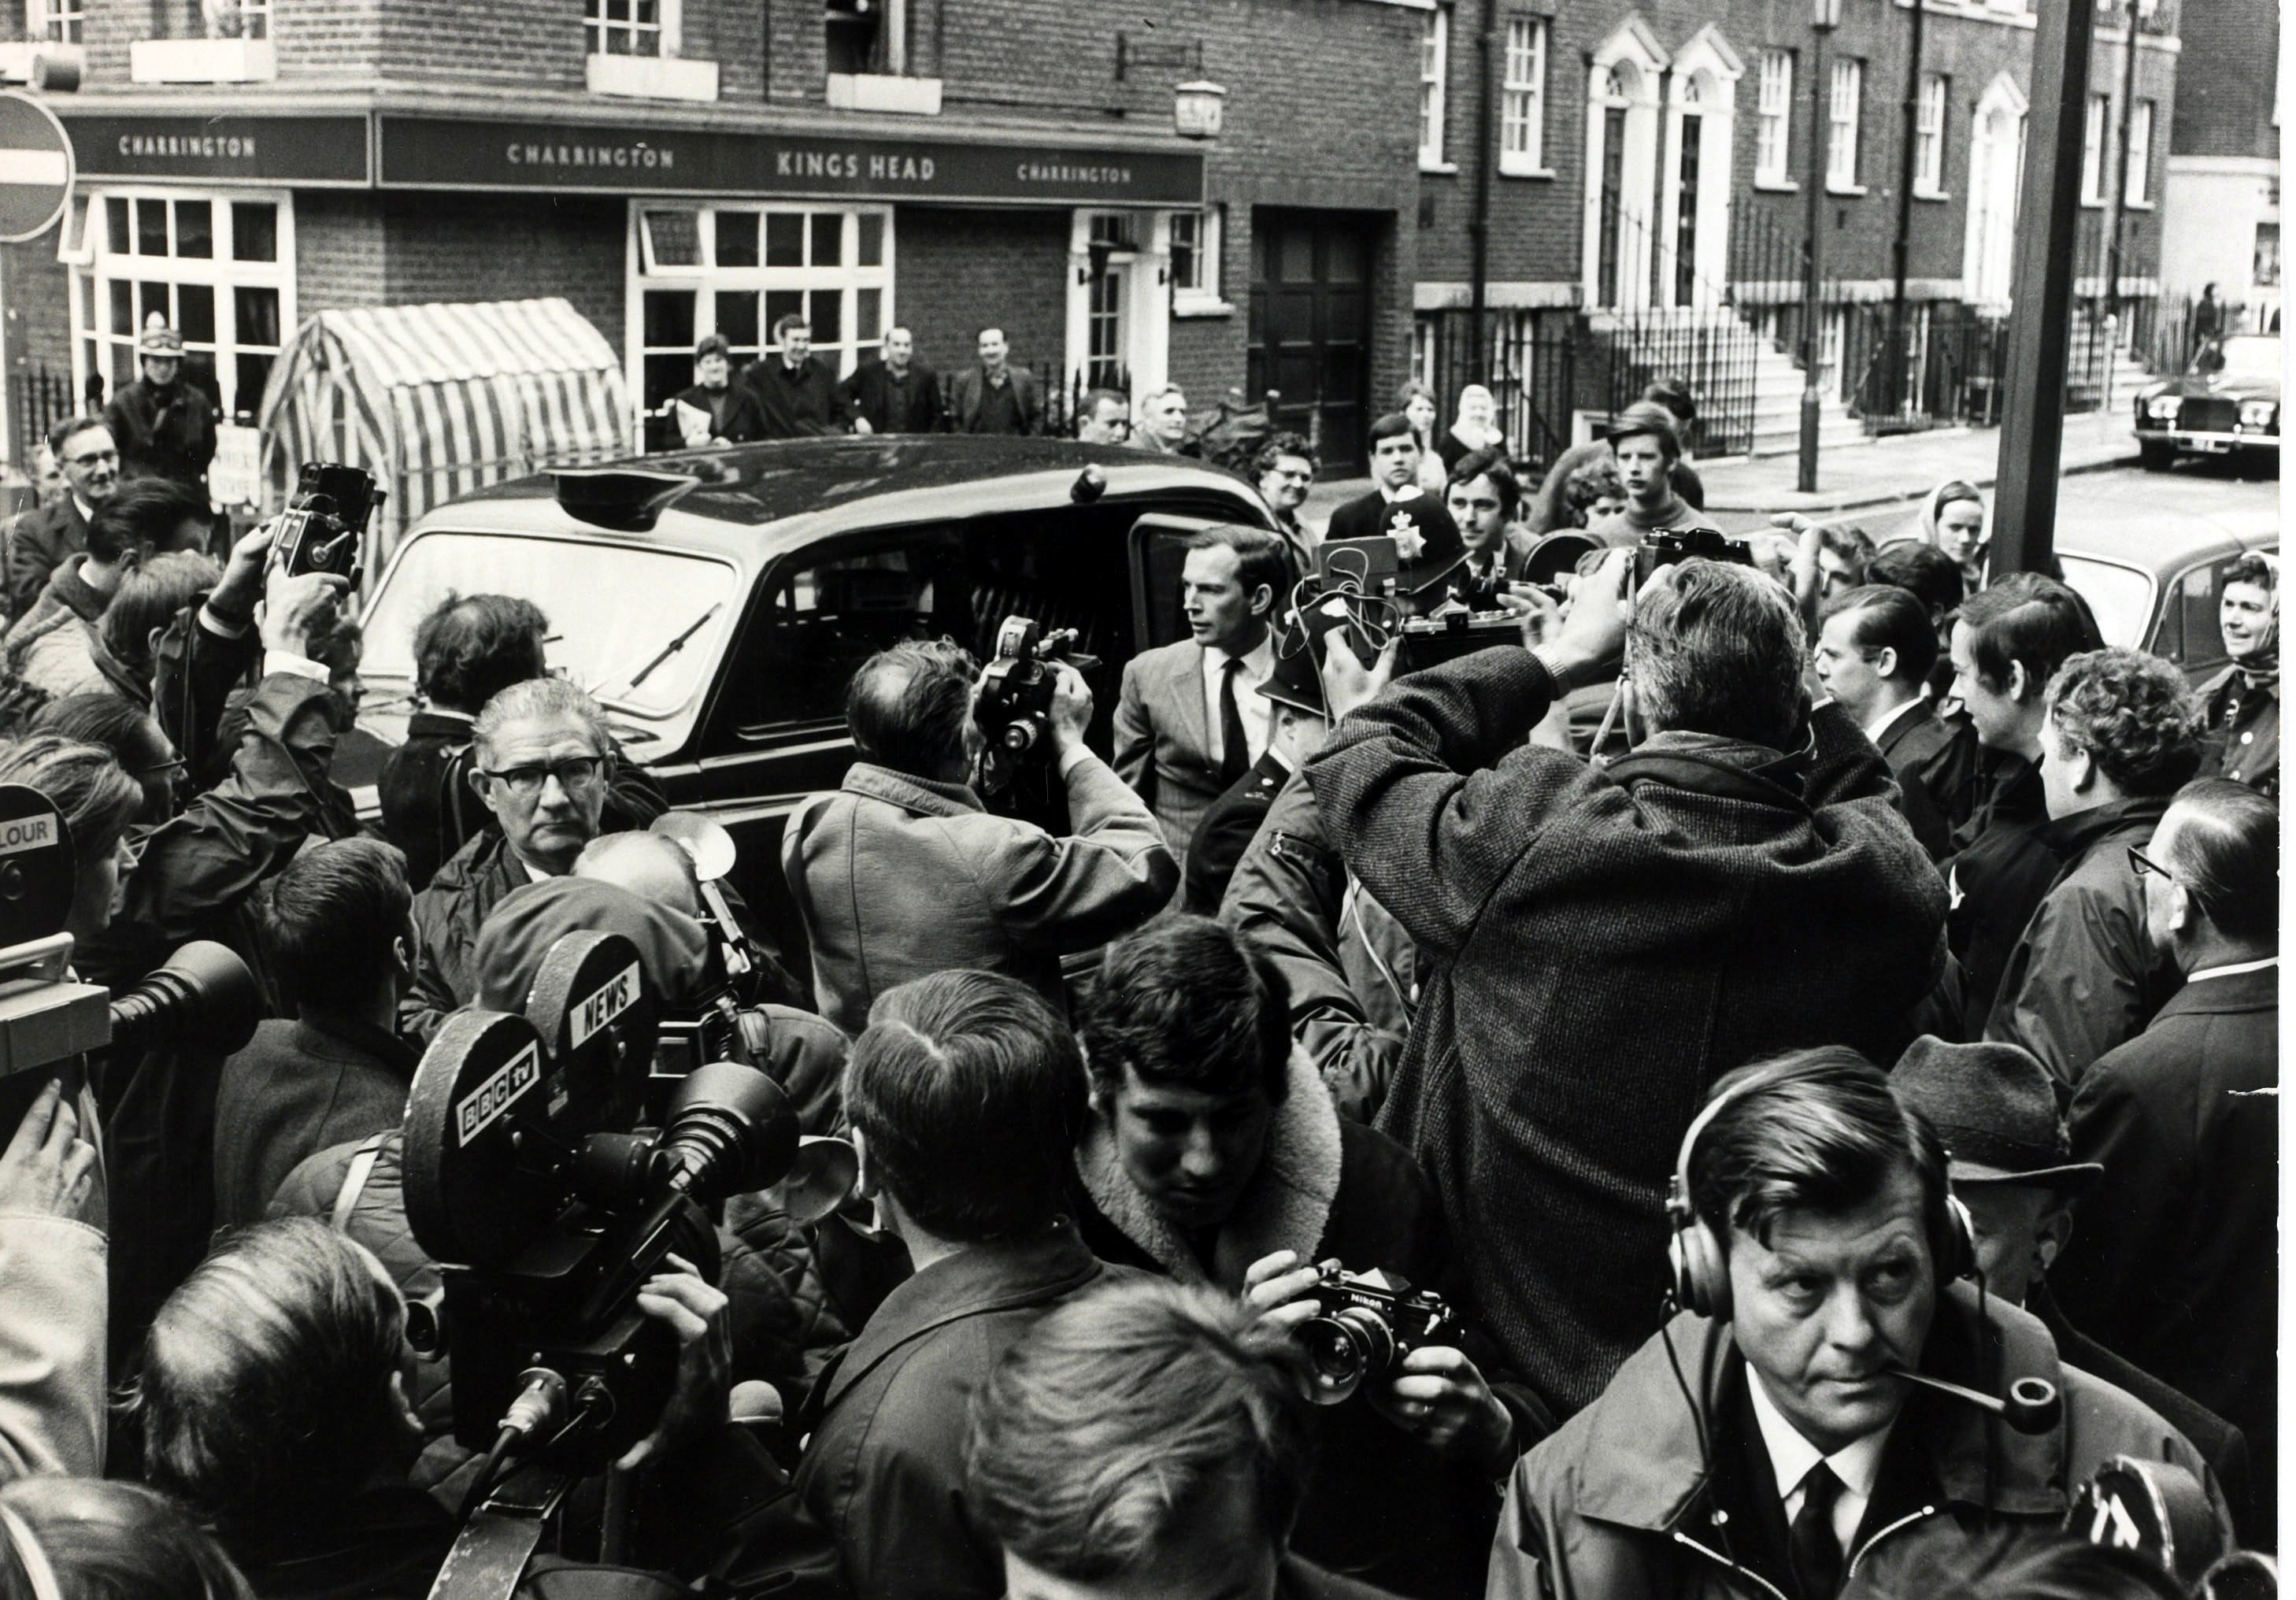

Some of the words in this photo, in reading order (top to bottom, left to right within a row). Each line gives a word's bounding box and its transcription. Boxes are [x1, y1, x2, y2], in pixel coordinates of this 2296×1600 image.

[119, 135, 255, 157] CHARRINGTON
[506, 143, 674, 169] CHARRINGTON
[777, 151, 858, 178] KINGS
[868, 154, 935, 181] HEAD
[1017, 163, 1131, 183] CHARRINGTON
[583, 975, 628, 1037] NEWS
[464, 1080, 507, 1131] BBC
[1350, 1293, 1383, 1309] Nikon
